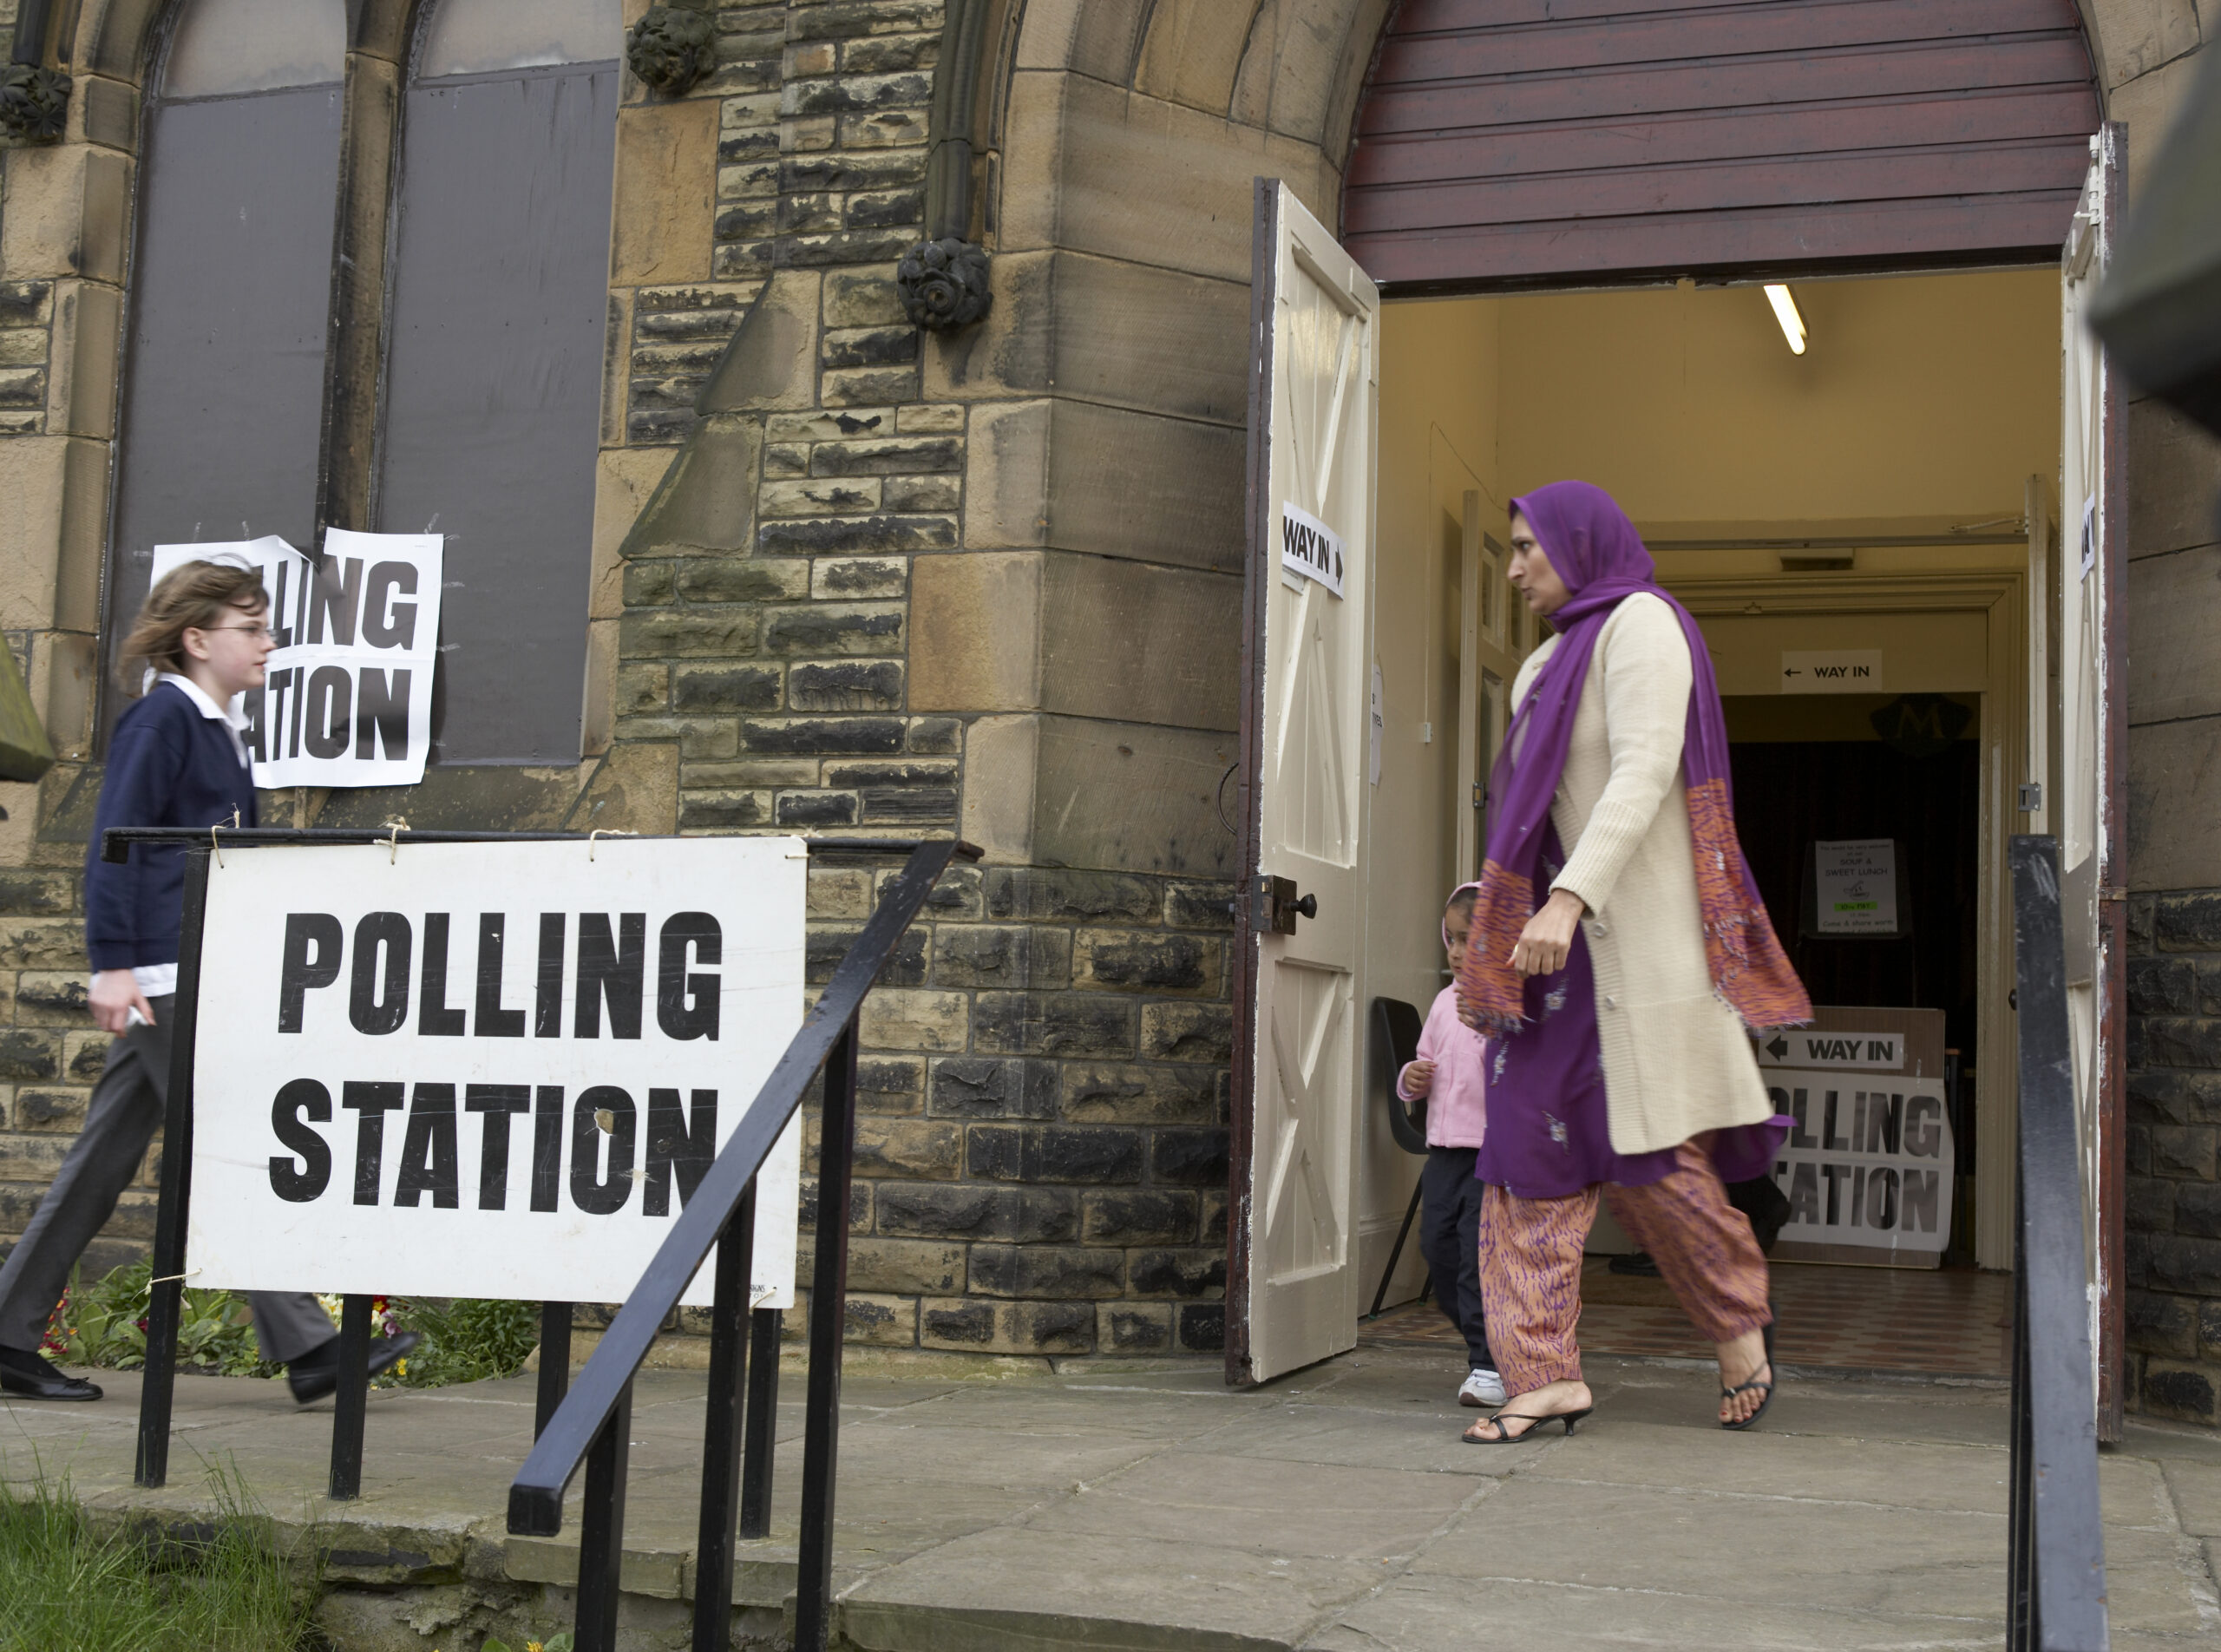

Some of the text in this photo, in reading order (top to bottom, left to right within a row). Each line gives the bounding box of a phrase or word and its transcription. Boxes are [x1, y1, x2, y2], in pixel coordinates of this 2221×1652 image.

[1283, 515, 1330, 574] WAY IN
[250, 554, 418, 651] LING
[1814, 665, 1870, 678] WAY IN
[240, 665, 412, 763] ATION
[278, 911, 723, 1041] POLLING
[1806, 1039, 1893, 1061] WAY IN
[268, 1078, 718, 1217] STATION
[1775, 1161, 1940, 1233] ATION
